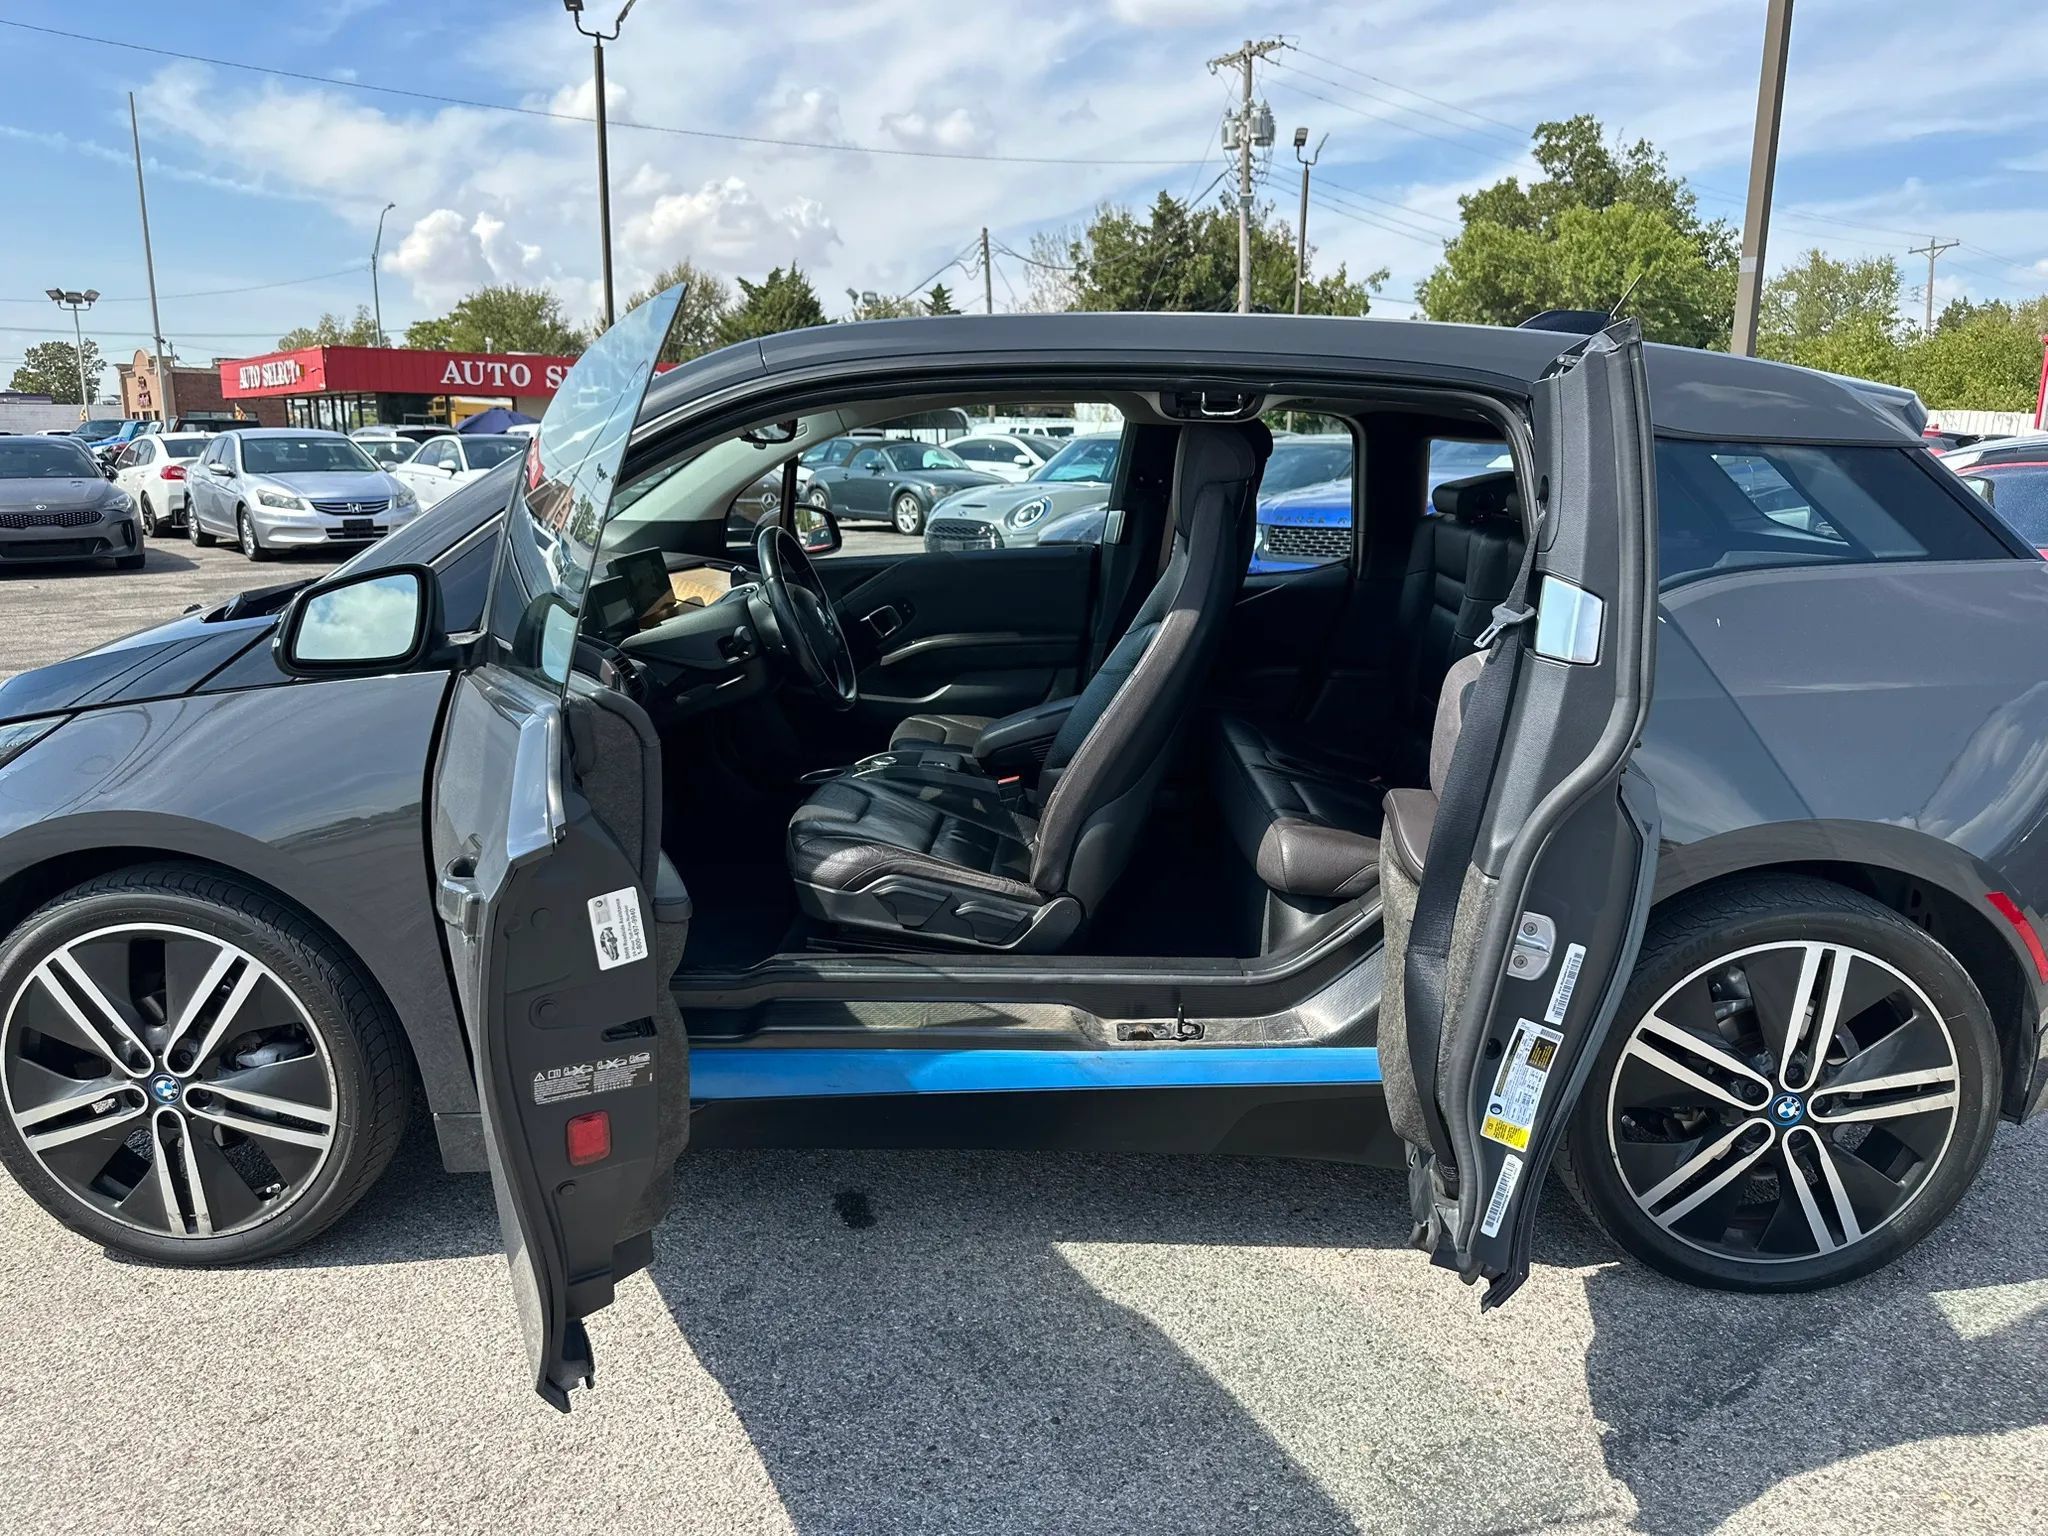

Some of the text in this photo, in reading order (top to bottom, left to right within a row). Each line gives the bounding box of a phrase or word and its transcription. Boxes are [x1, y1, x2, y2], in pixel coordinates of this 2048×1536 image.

[240, 360, 296, 389] AUTO SELECT
[440, 360, 531, 387] AUTO
